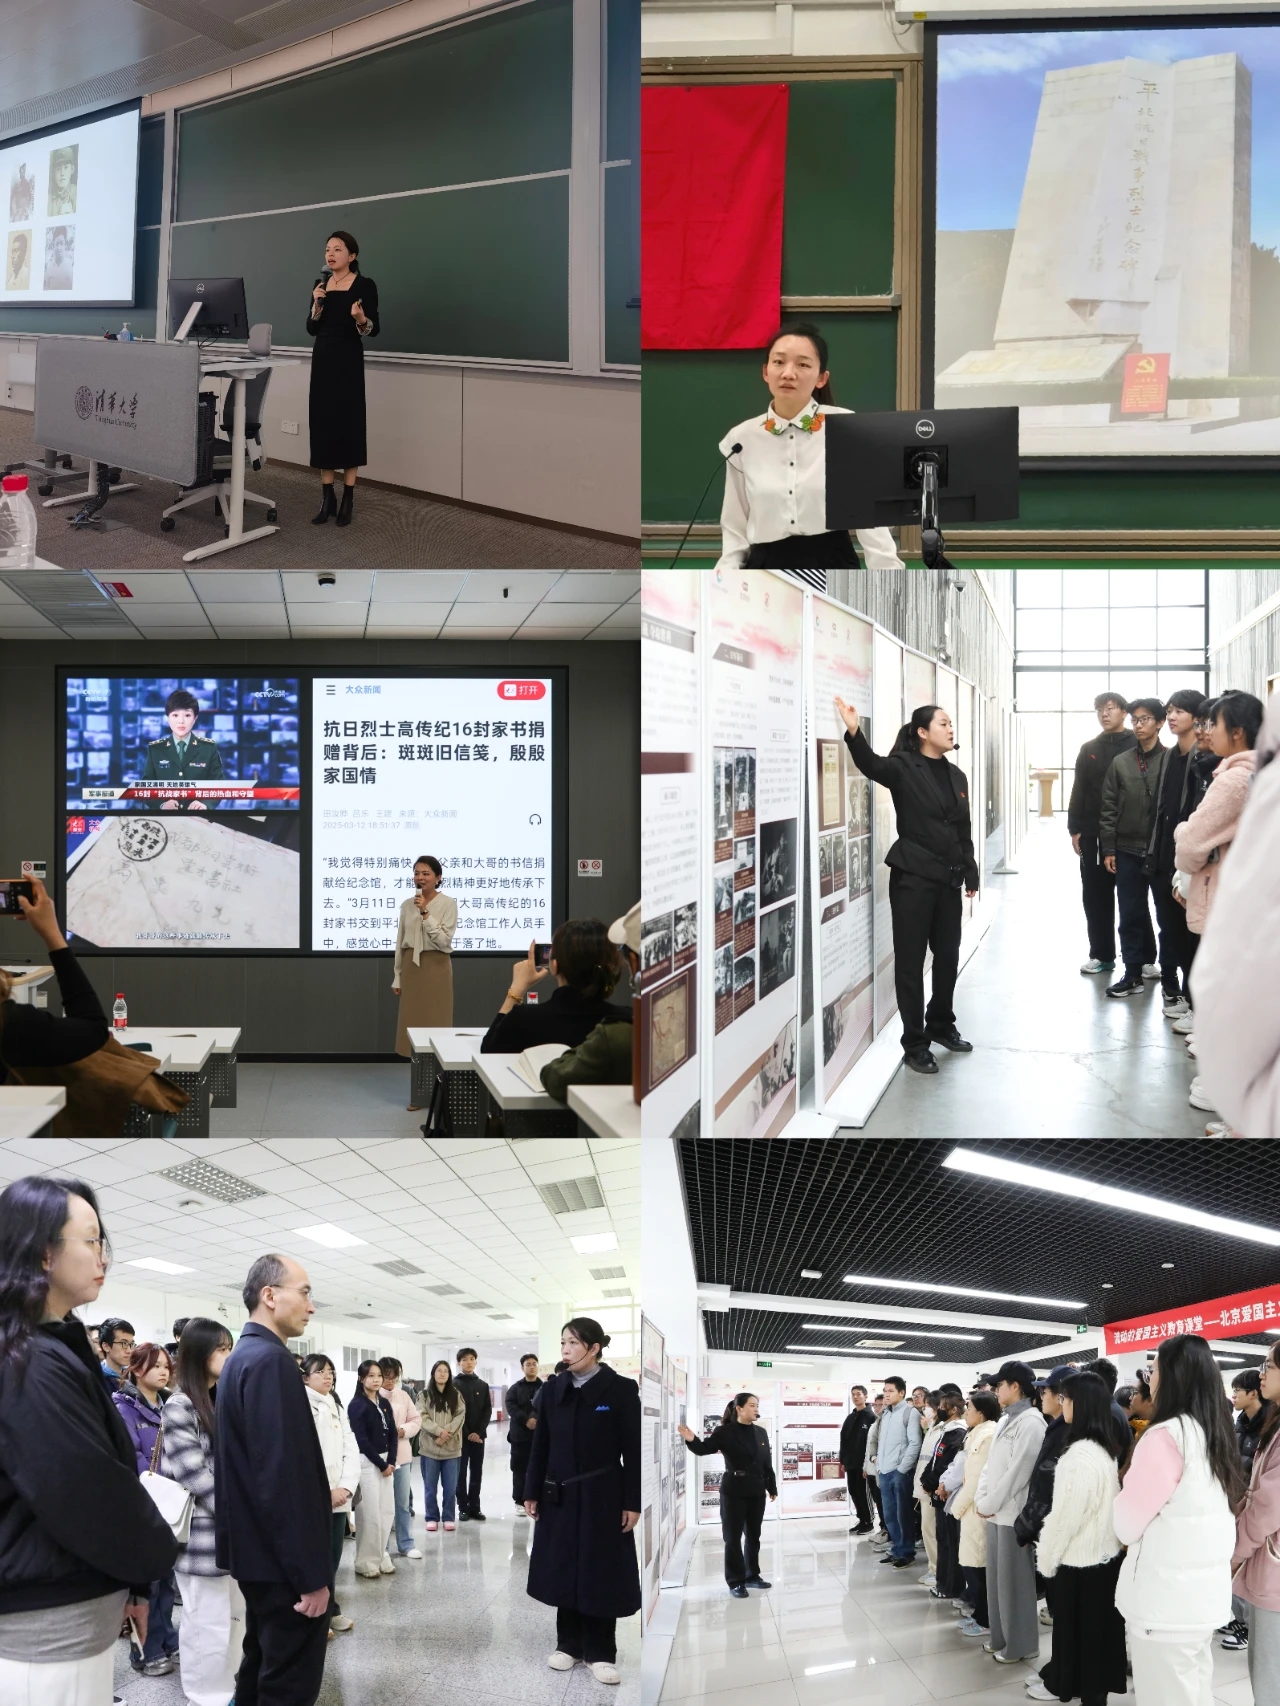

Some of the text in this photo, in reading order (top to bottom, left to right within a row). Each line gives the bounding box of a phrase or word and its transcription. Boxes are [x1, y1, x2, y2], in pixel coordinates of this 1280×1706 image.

[345, 685, 381, 695] 大众新闻
[518, 685, 539, 696] 打开
[323, 720, 545, 738] 抗日烈士高传纪16封家书捐
[323, 743, 545, 762] 赠背后：斑斑旧信笺，殷殷
[323, 767, 377, 784] 家国情
[352, 809, 369, 818] 吕乐
[376, 809, 392, 818] 王建
[323, 821, 366, 829] 2025-03-12
[368, 821, 401, 829] 18:51:37
[439, 857, 545, 869] 父亲和大哥的书信捐
